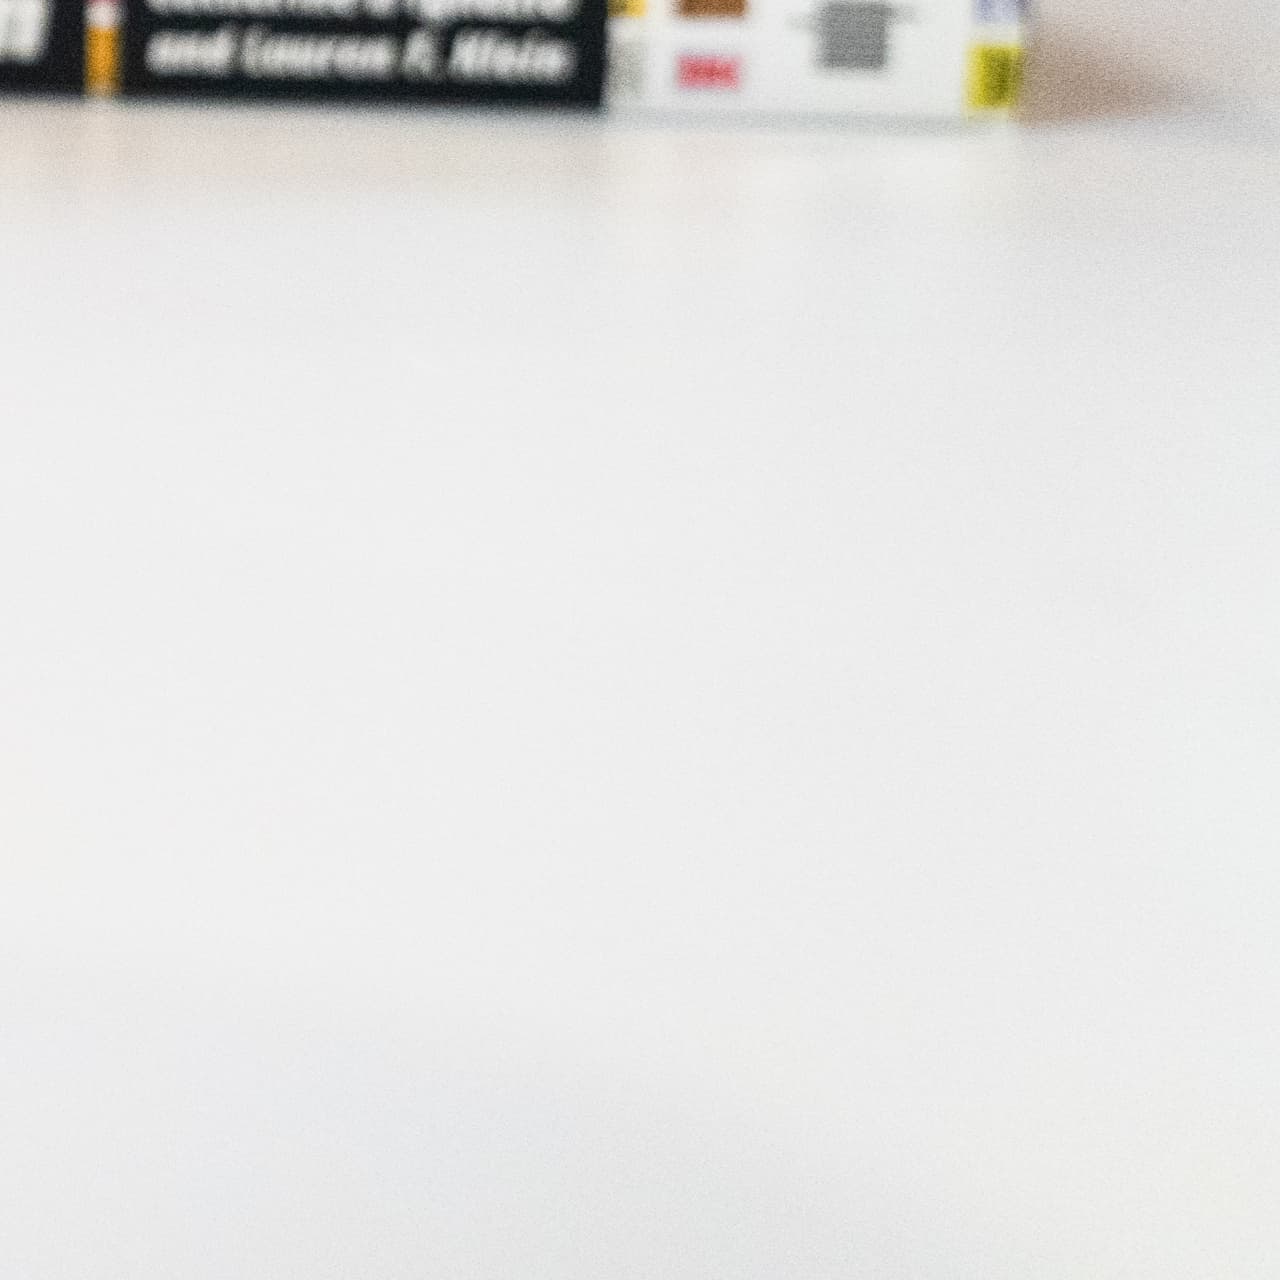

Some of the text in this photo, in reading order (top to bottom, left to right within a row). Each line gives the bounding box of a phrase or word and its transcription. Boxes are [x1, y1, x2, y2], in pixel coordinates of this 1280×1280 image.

[143, 26, 231, 78] and
[240, 27, 390, 80] Lauren
[446, 30, 569, 82] Klein
